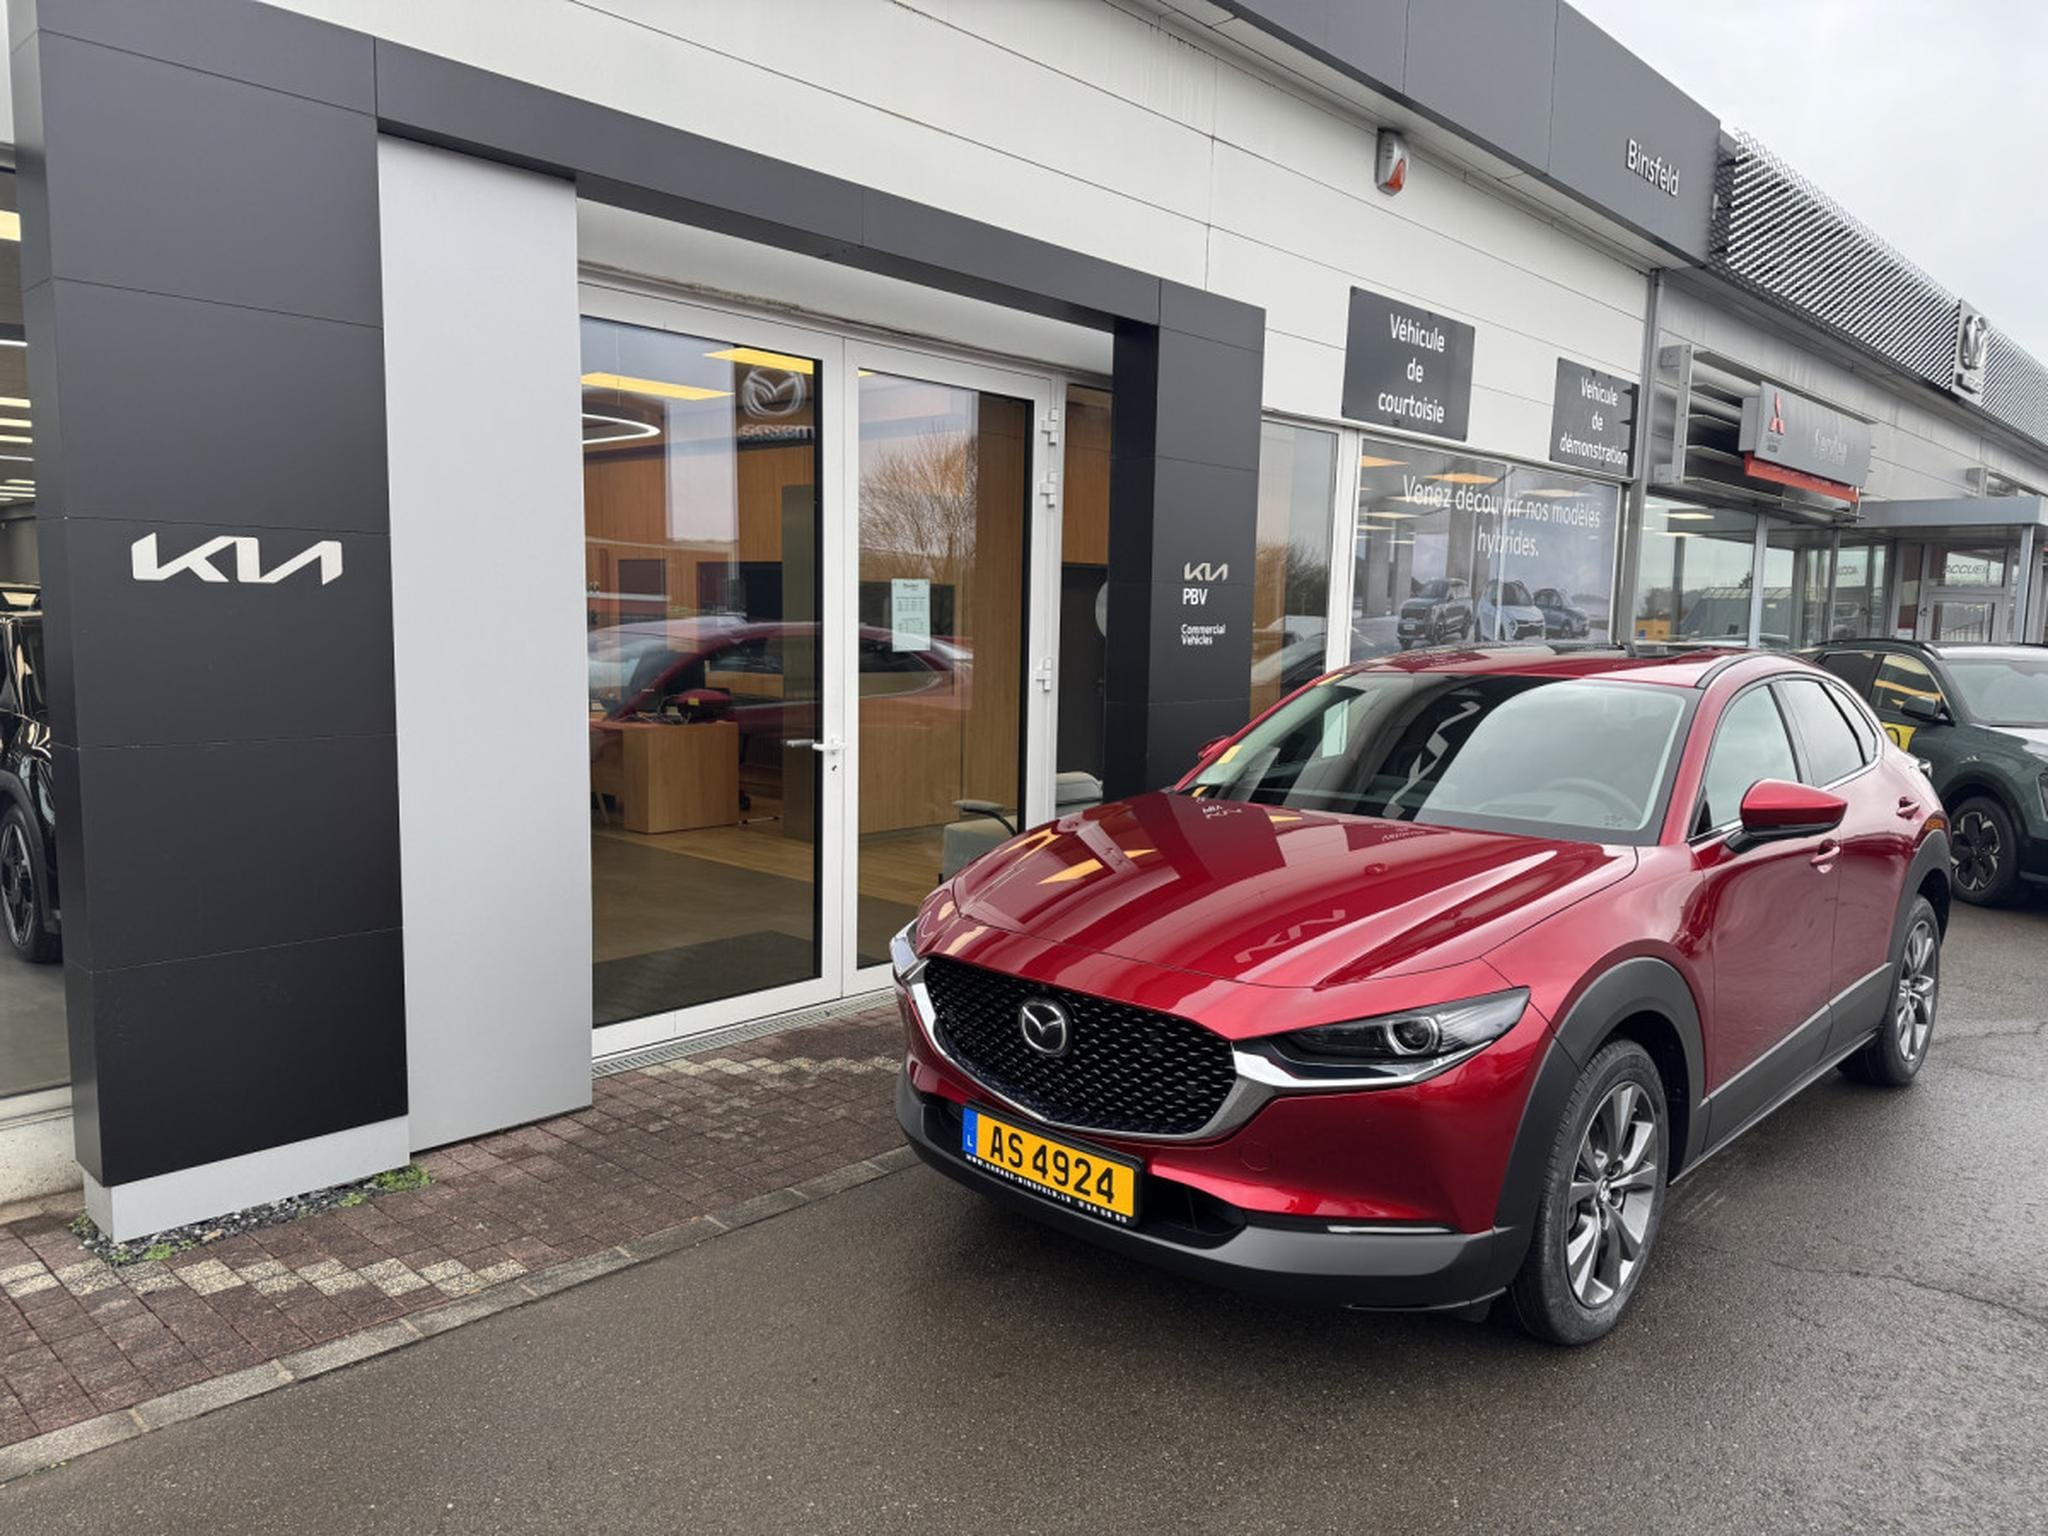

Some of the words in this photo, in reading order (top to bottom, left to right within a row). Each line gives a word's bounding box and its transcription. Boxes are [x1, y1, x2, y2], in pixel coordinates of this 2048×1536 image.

[1627, 139, 1679, 196] Binsfeld
[1390, 313, 1445, 353] Véhicule
[1406, 358, 1424, 383] de
[1378, 392, 1445, 423] courtoisie
[1592, 411, 1603, 431] de
[1560, 432, 1628, 466] démonstration
[1402, 475, 1451, 508] Venez
[1455, 484, 1525, 517] découvrir
[1526, 500, 1549, 521] nos
[1552, 502, 1601, 529] modèles
[1477, 525, 1540, 558] hybrides.
[131, 532, 343, 586] KIA
[1182, 588, 1208, 605] PBV
[1181, 624, 1226, 635] Commercial
[1181, 634, 1213, 646] Vehicles
[966, 1135, 974, 1147] L
[990, 1126, 1023, 1168] AS
[1032, 1144, 1115, 1204] 4924
